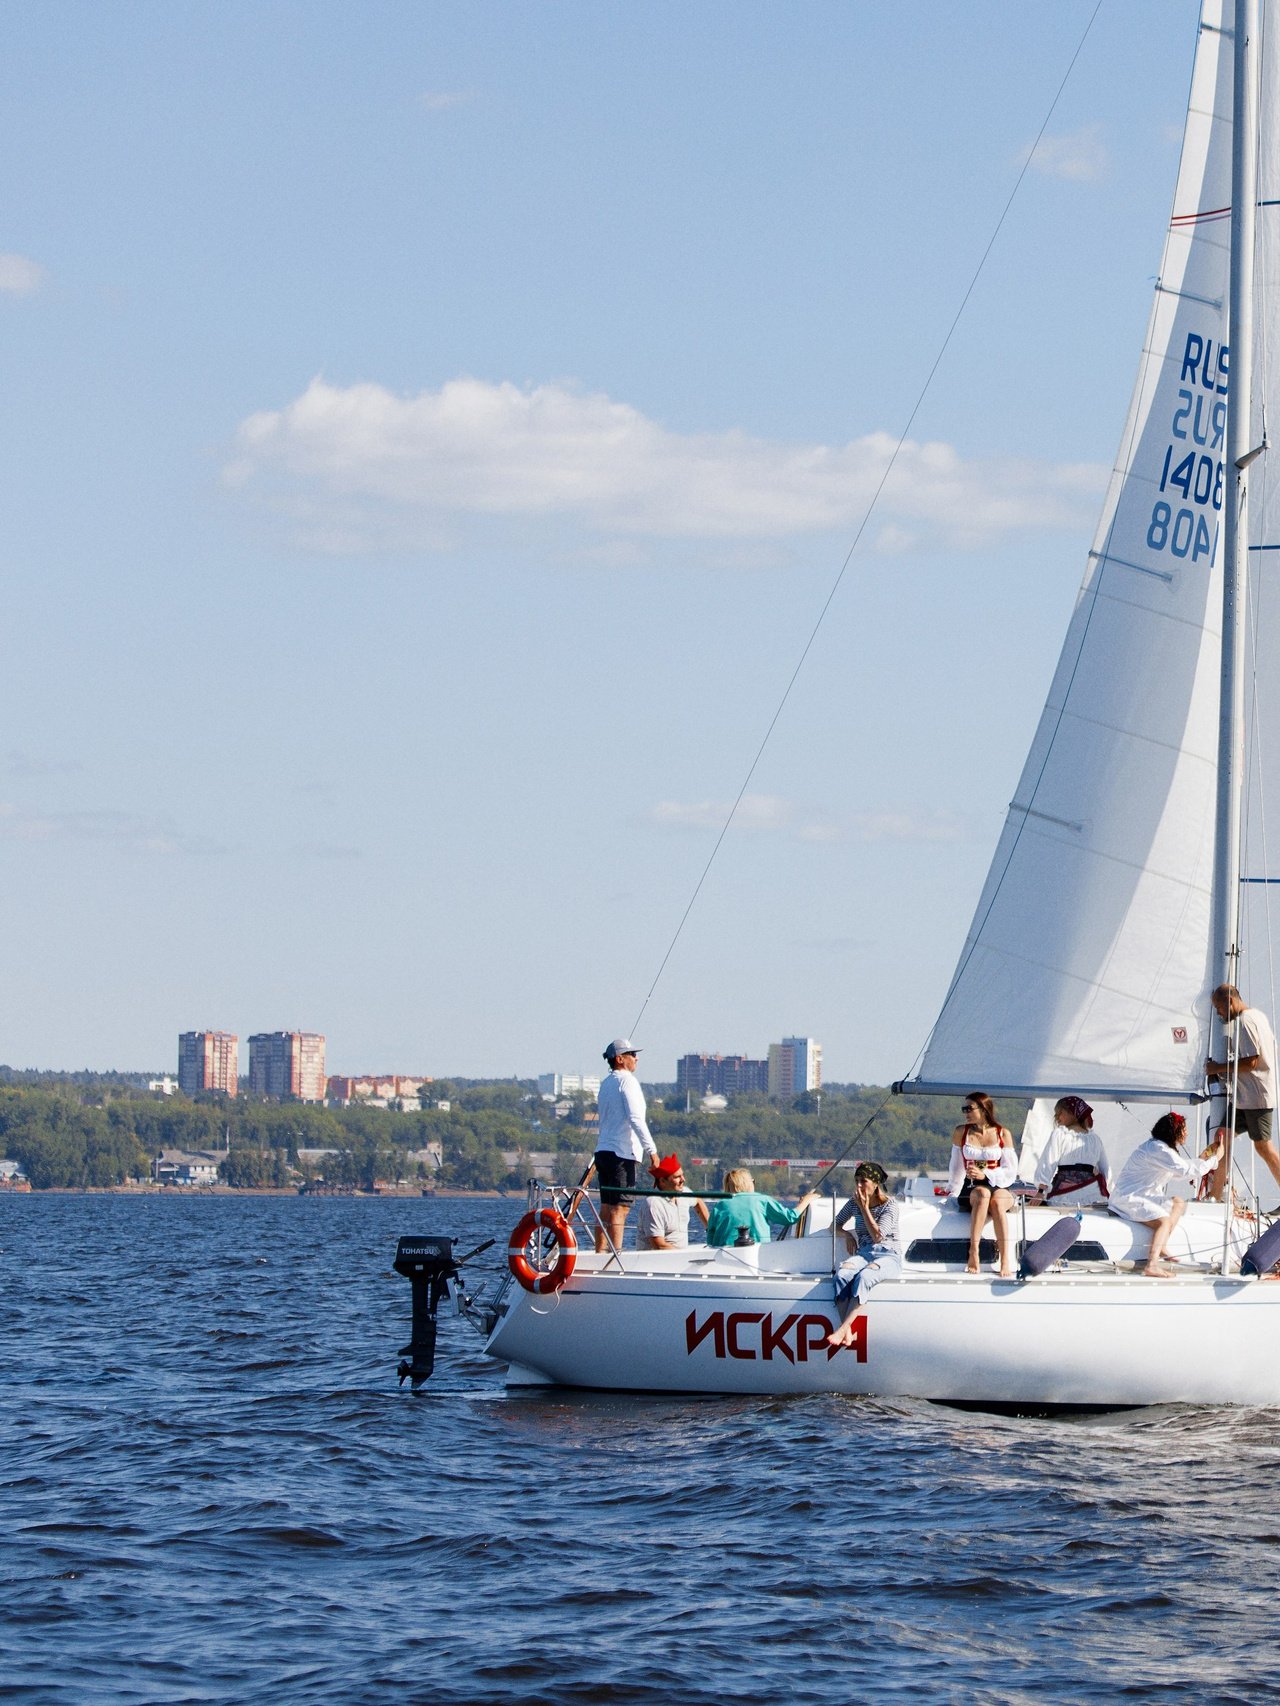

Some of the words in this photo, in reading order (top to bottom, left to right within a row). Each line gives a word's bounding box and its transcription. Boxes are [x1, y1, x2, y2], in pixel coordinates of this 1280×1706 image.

[1180, 333, 1229, 395] RUS
[401, 1247, 434, 1255] TOHATSU
[685, 1309, 868, 1366] ИСКРА
